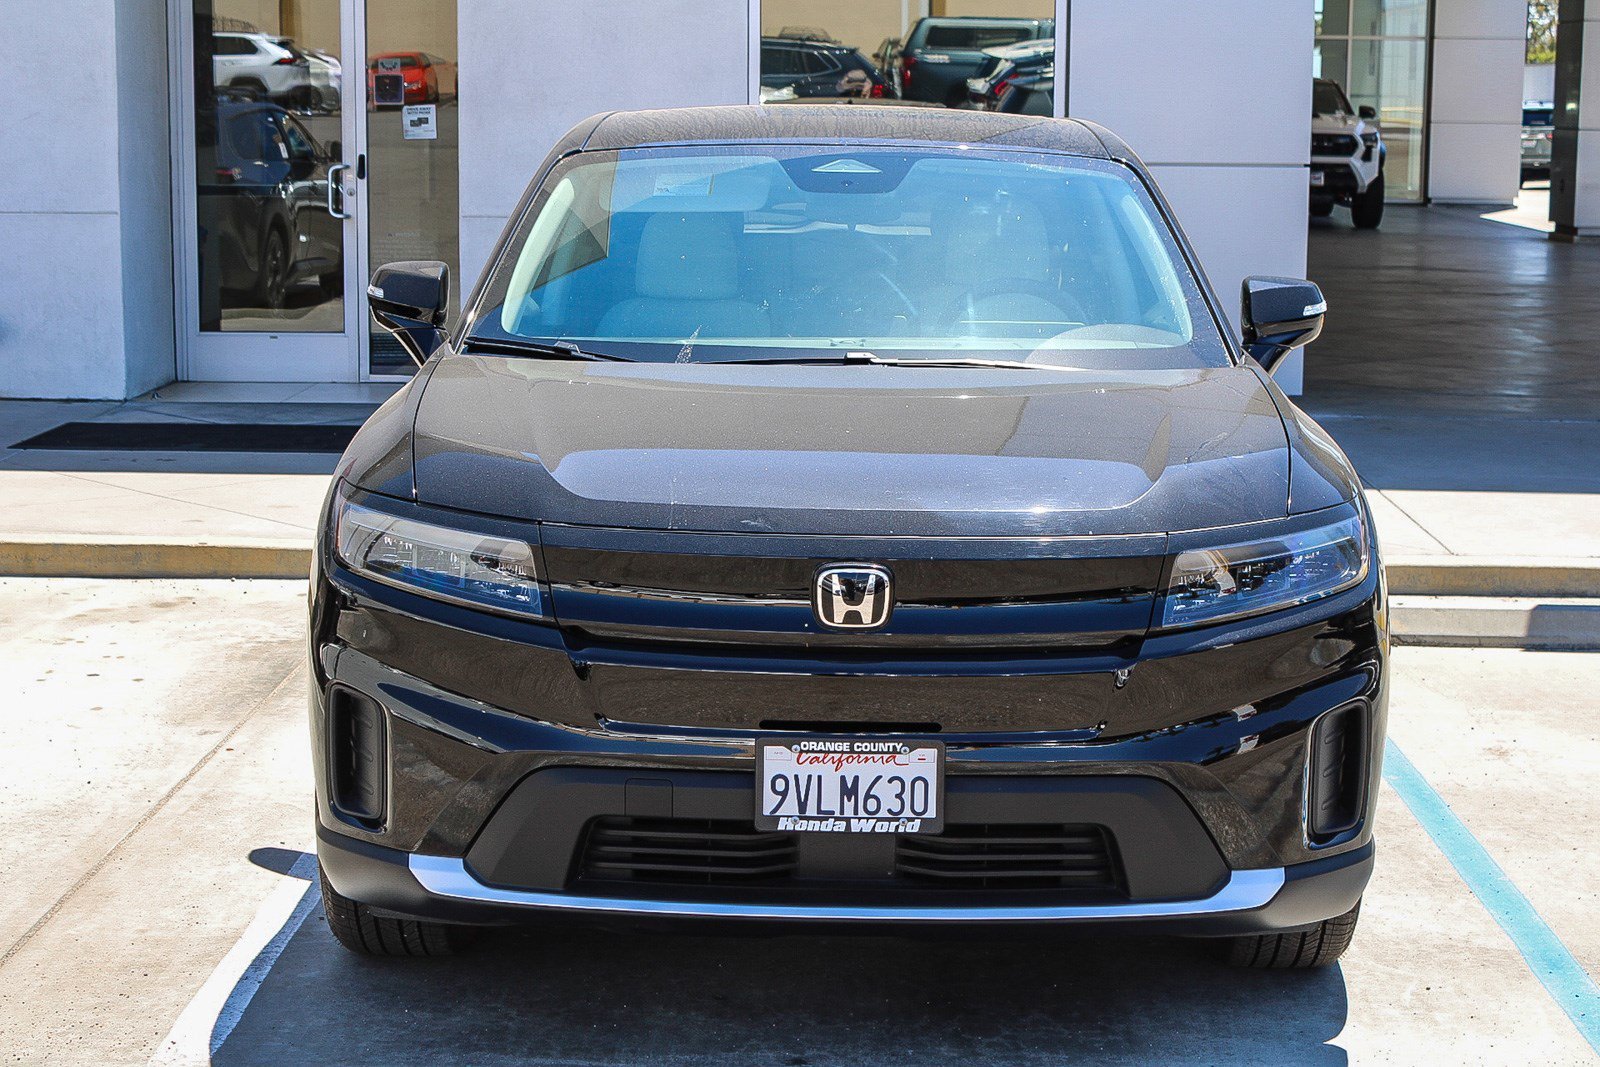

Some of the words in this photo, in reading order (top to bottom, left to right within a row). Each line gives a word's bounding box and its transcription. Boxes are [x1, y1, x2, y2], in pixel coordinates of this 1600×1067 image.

[800, 741, 851, 752] ORANGE
[853, 742, 903, 753] COUNTY
[796, 752, 909, 772] California
[769, 773, 929, 817] 9VLM630
[777, 816, 847, 832] Honda
